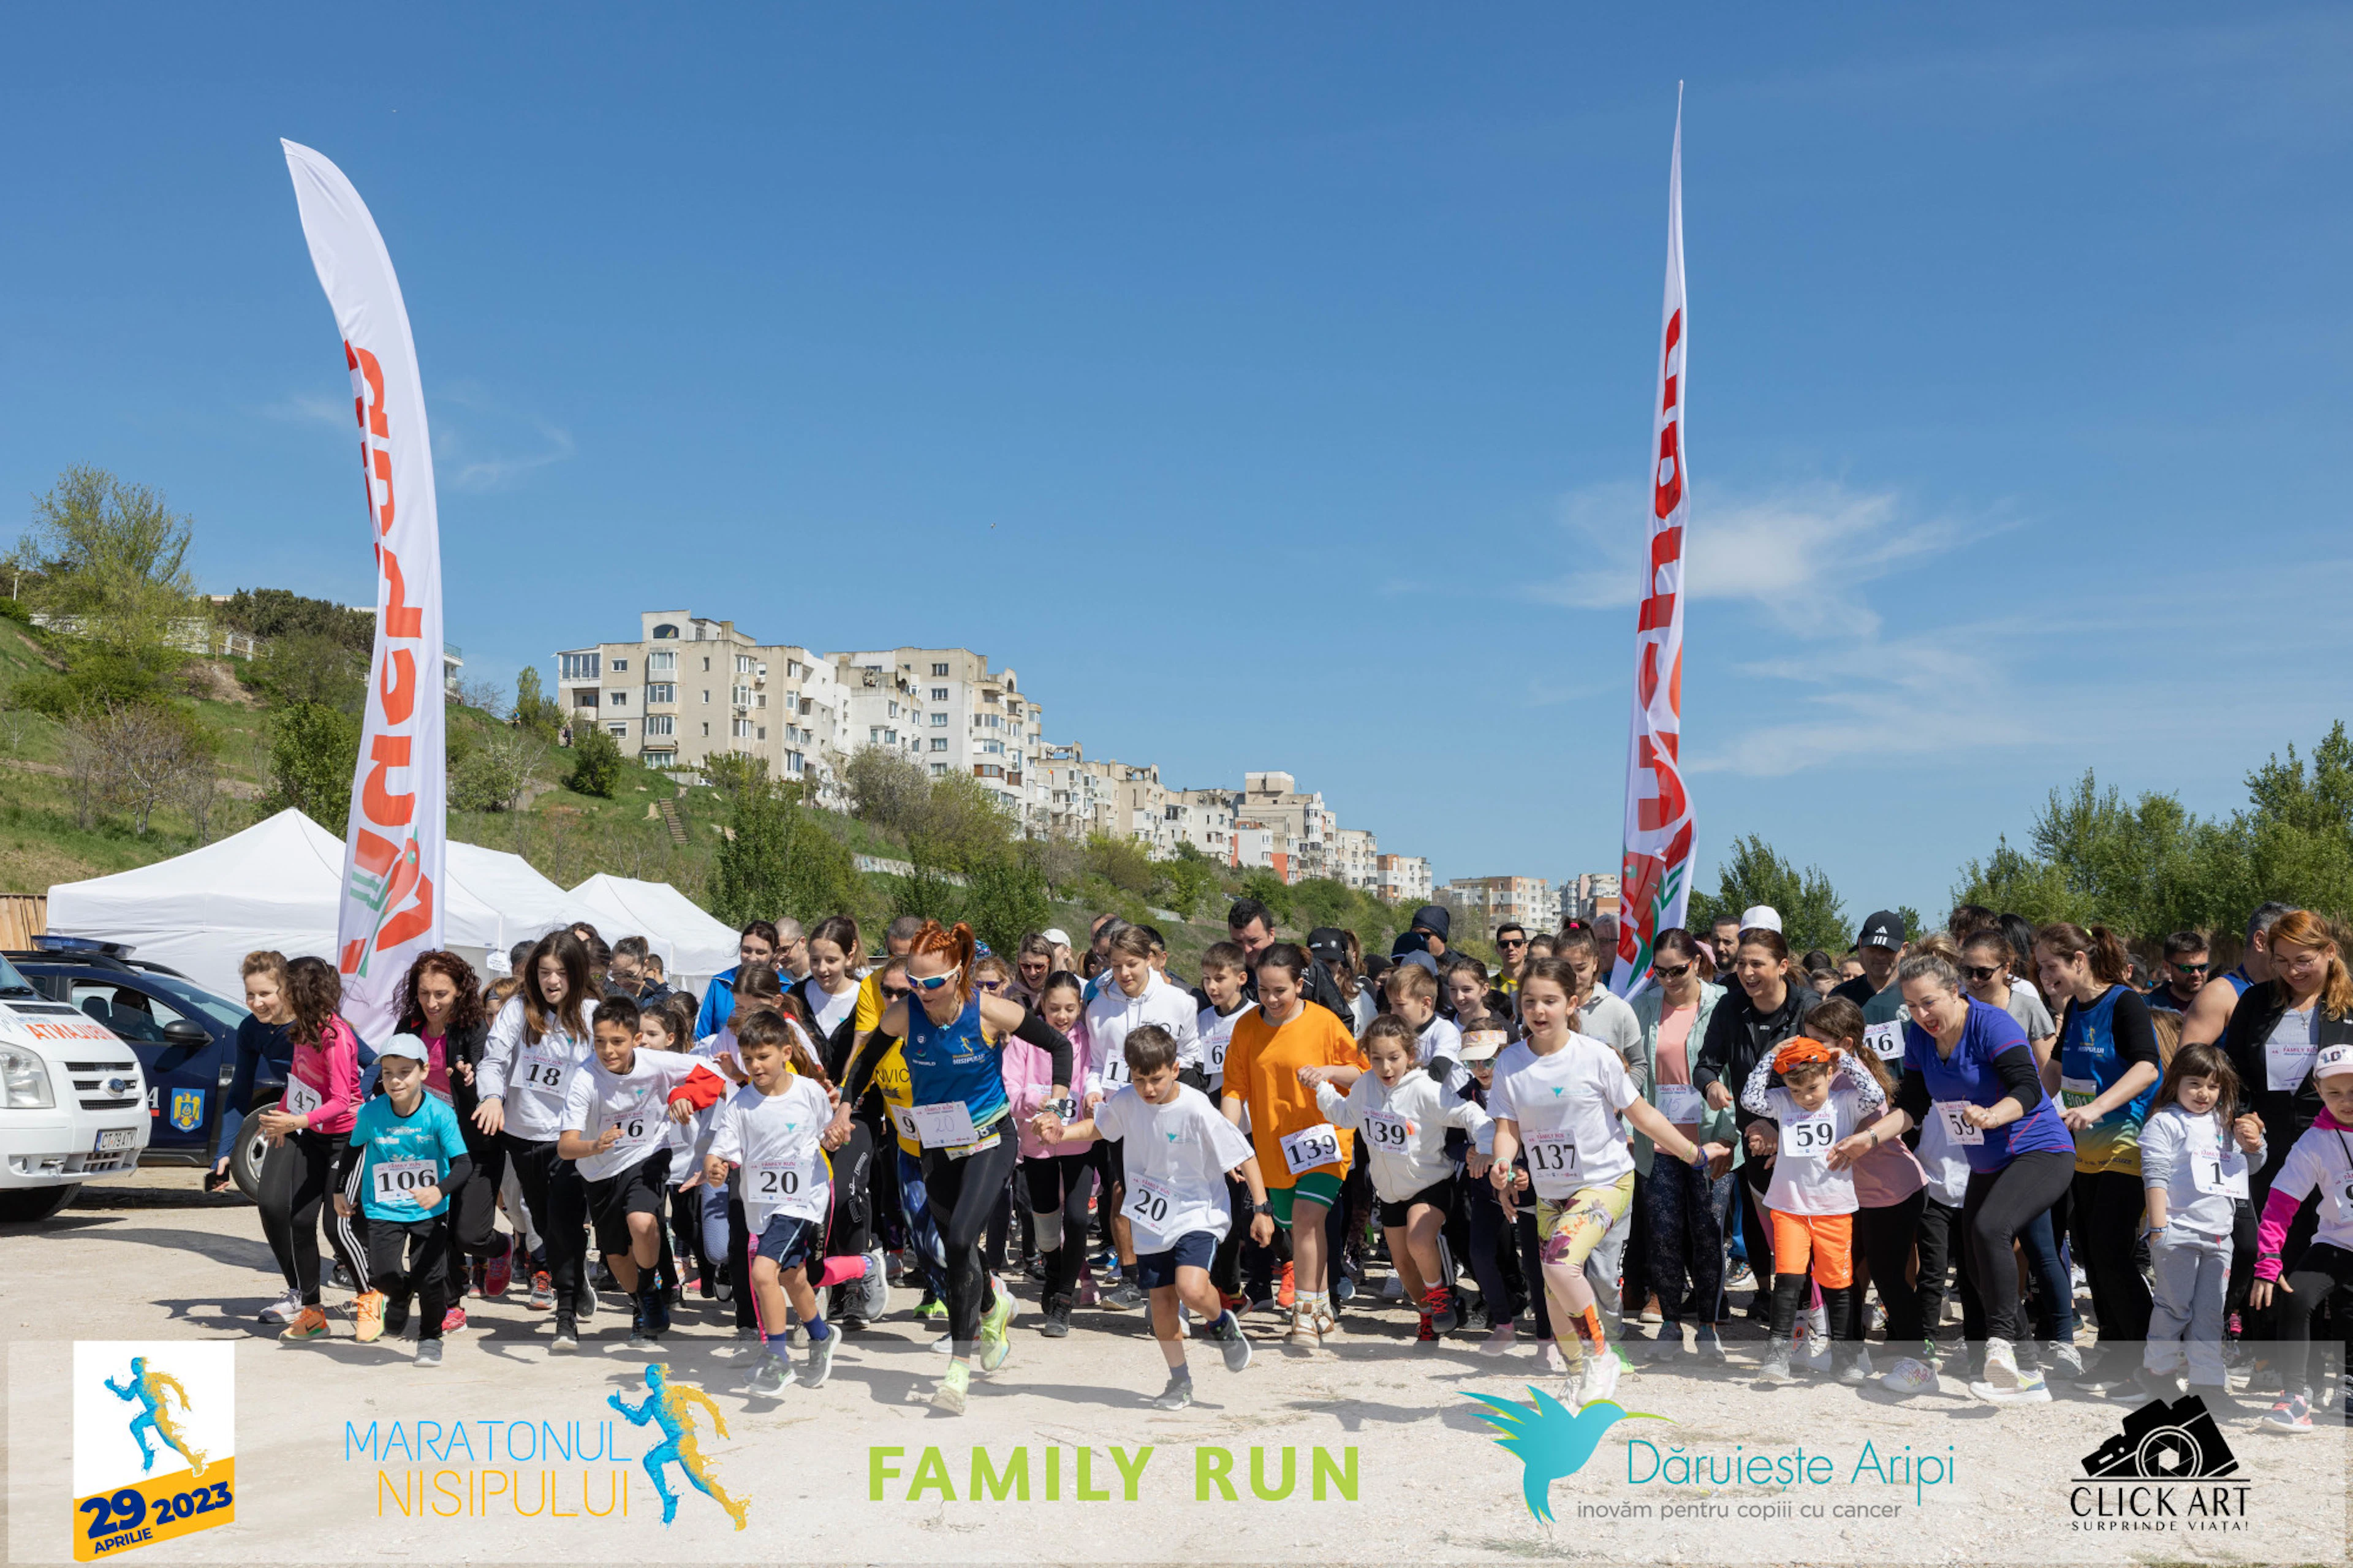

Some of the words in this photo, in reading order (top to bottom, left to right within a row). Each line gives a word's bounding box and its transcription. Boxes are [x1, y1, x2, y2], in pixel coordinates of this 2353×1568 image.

[526, 1064, 561, 1086] 18
[294, 1091, 316, 1112] 47
[1365, 1118, 1405, 1145] 139
[1797, 1123, 1833, 1146] 59
[1288, 1135, 1336, 1165] 139
[1531, 1144, 1576, 1170] 137
[378, 1169, 436, 1192] 106
[760, 1171, 798, 1194] 20
[2210, 1162, 2225, 1186] 1
[1134, 1189, 1168, 1222] 20
